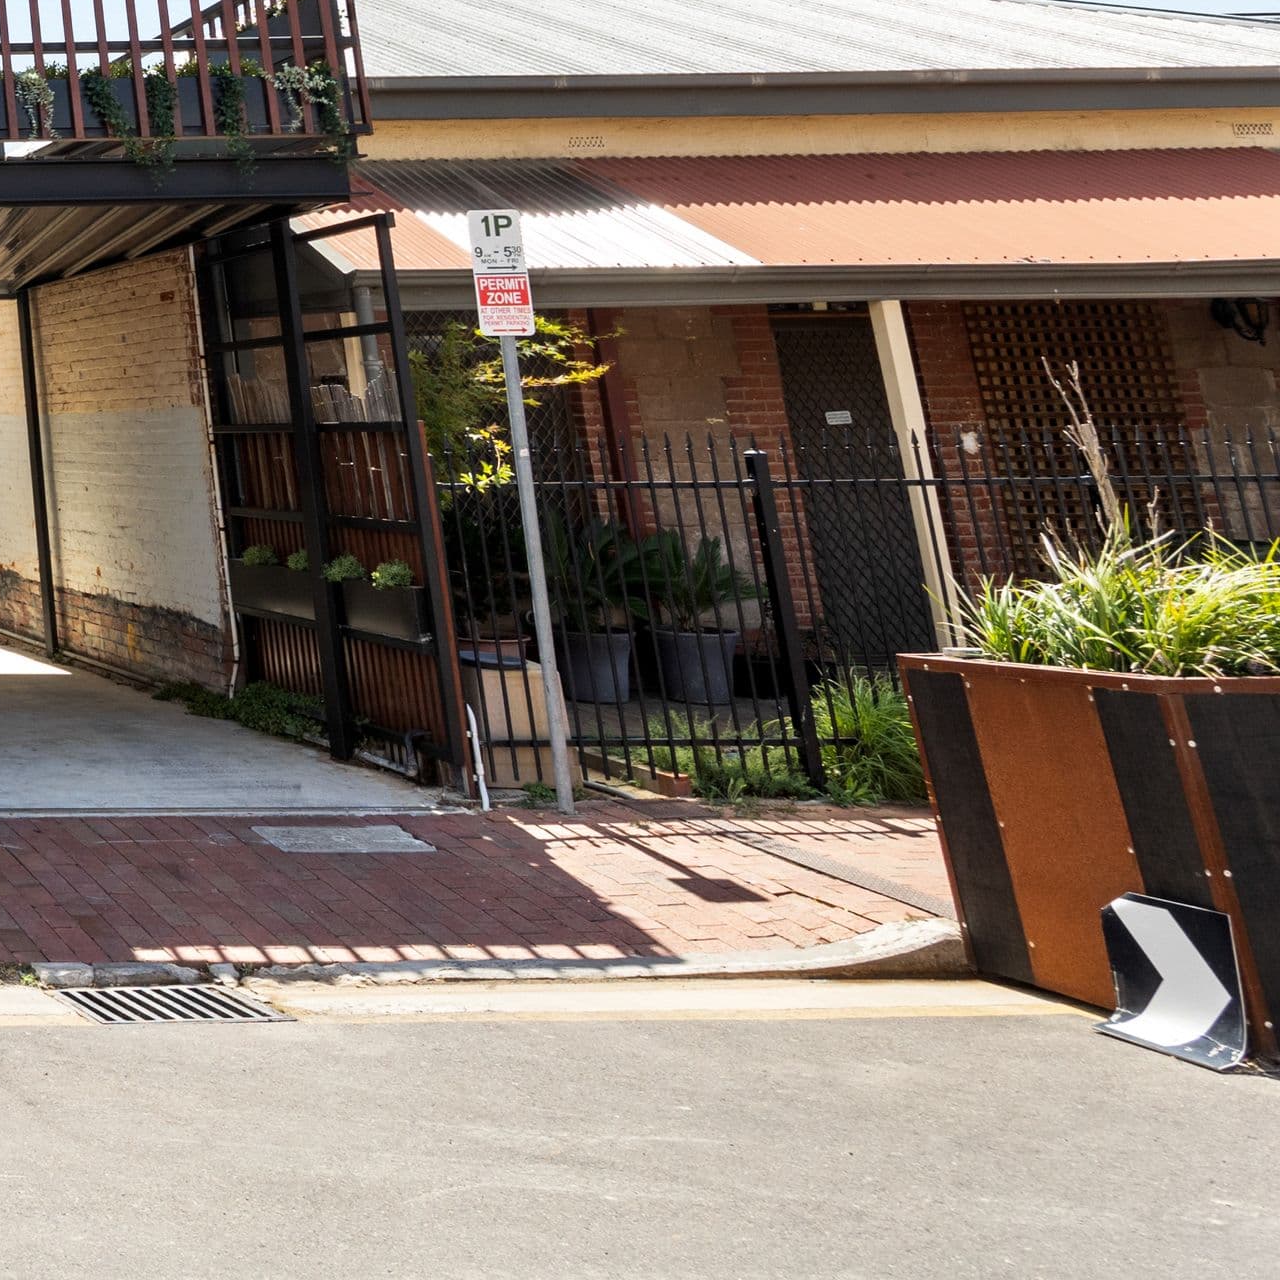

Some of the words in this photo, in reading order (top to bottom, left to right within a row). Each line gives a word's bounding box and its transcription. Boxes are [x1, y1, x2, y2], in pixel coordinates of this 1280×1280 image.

[480, 214, 513, 237] 1P
[479, 278, 526, 291] PERMIT
[486, 291, 522, 305] ZONE
